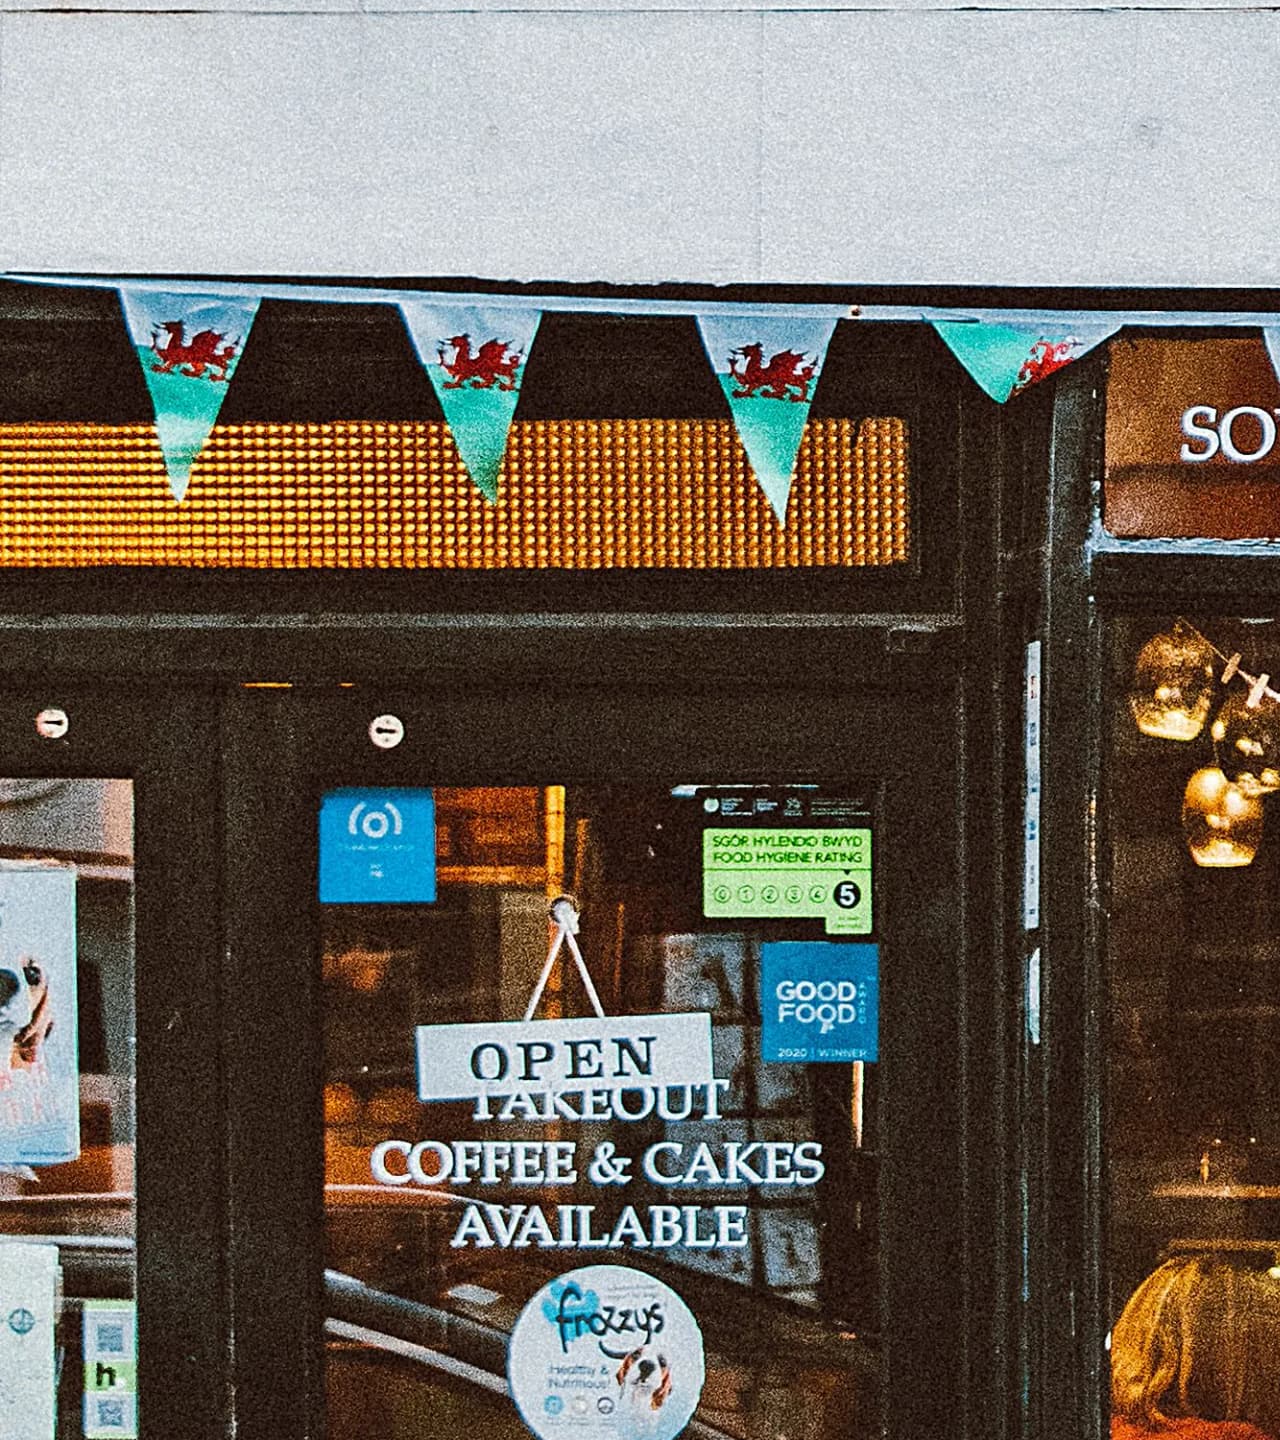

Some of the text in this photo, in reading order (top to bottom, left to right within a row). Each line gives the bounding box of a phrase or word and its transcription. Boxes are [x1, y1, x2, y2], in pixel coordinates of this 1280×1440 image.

[822, 836, 863, 847] BWYD
[713, 852, 863, 863] FOOD HYGIENE RATING
[839, 884, 856, 907] 5
[776, 980, 857, 1001] GOOD
[778, 1003, 857, 1024] FOOD
[470, 1036, 657, 1081] OPEN
[778, 1048, 808, 1057] 2020
[473, 1079, 730, 1121] TAKEOUT
[370, 1140, 826, 1185] COFFEE & CAKES
[450, 1204, 749, 1249] AVAILABLE
